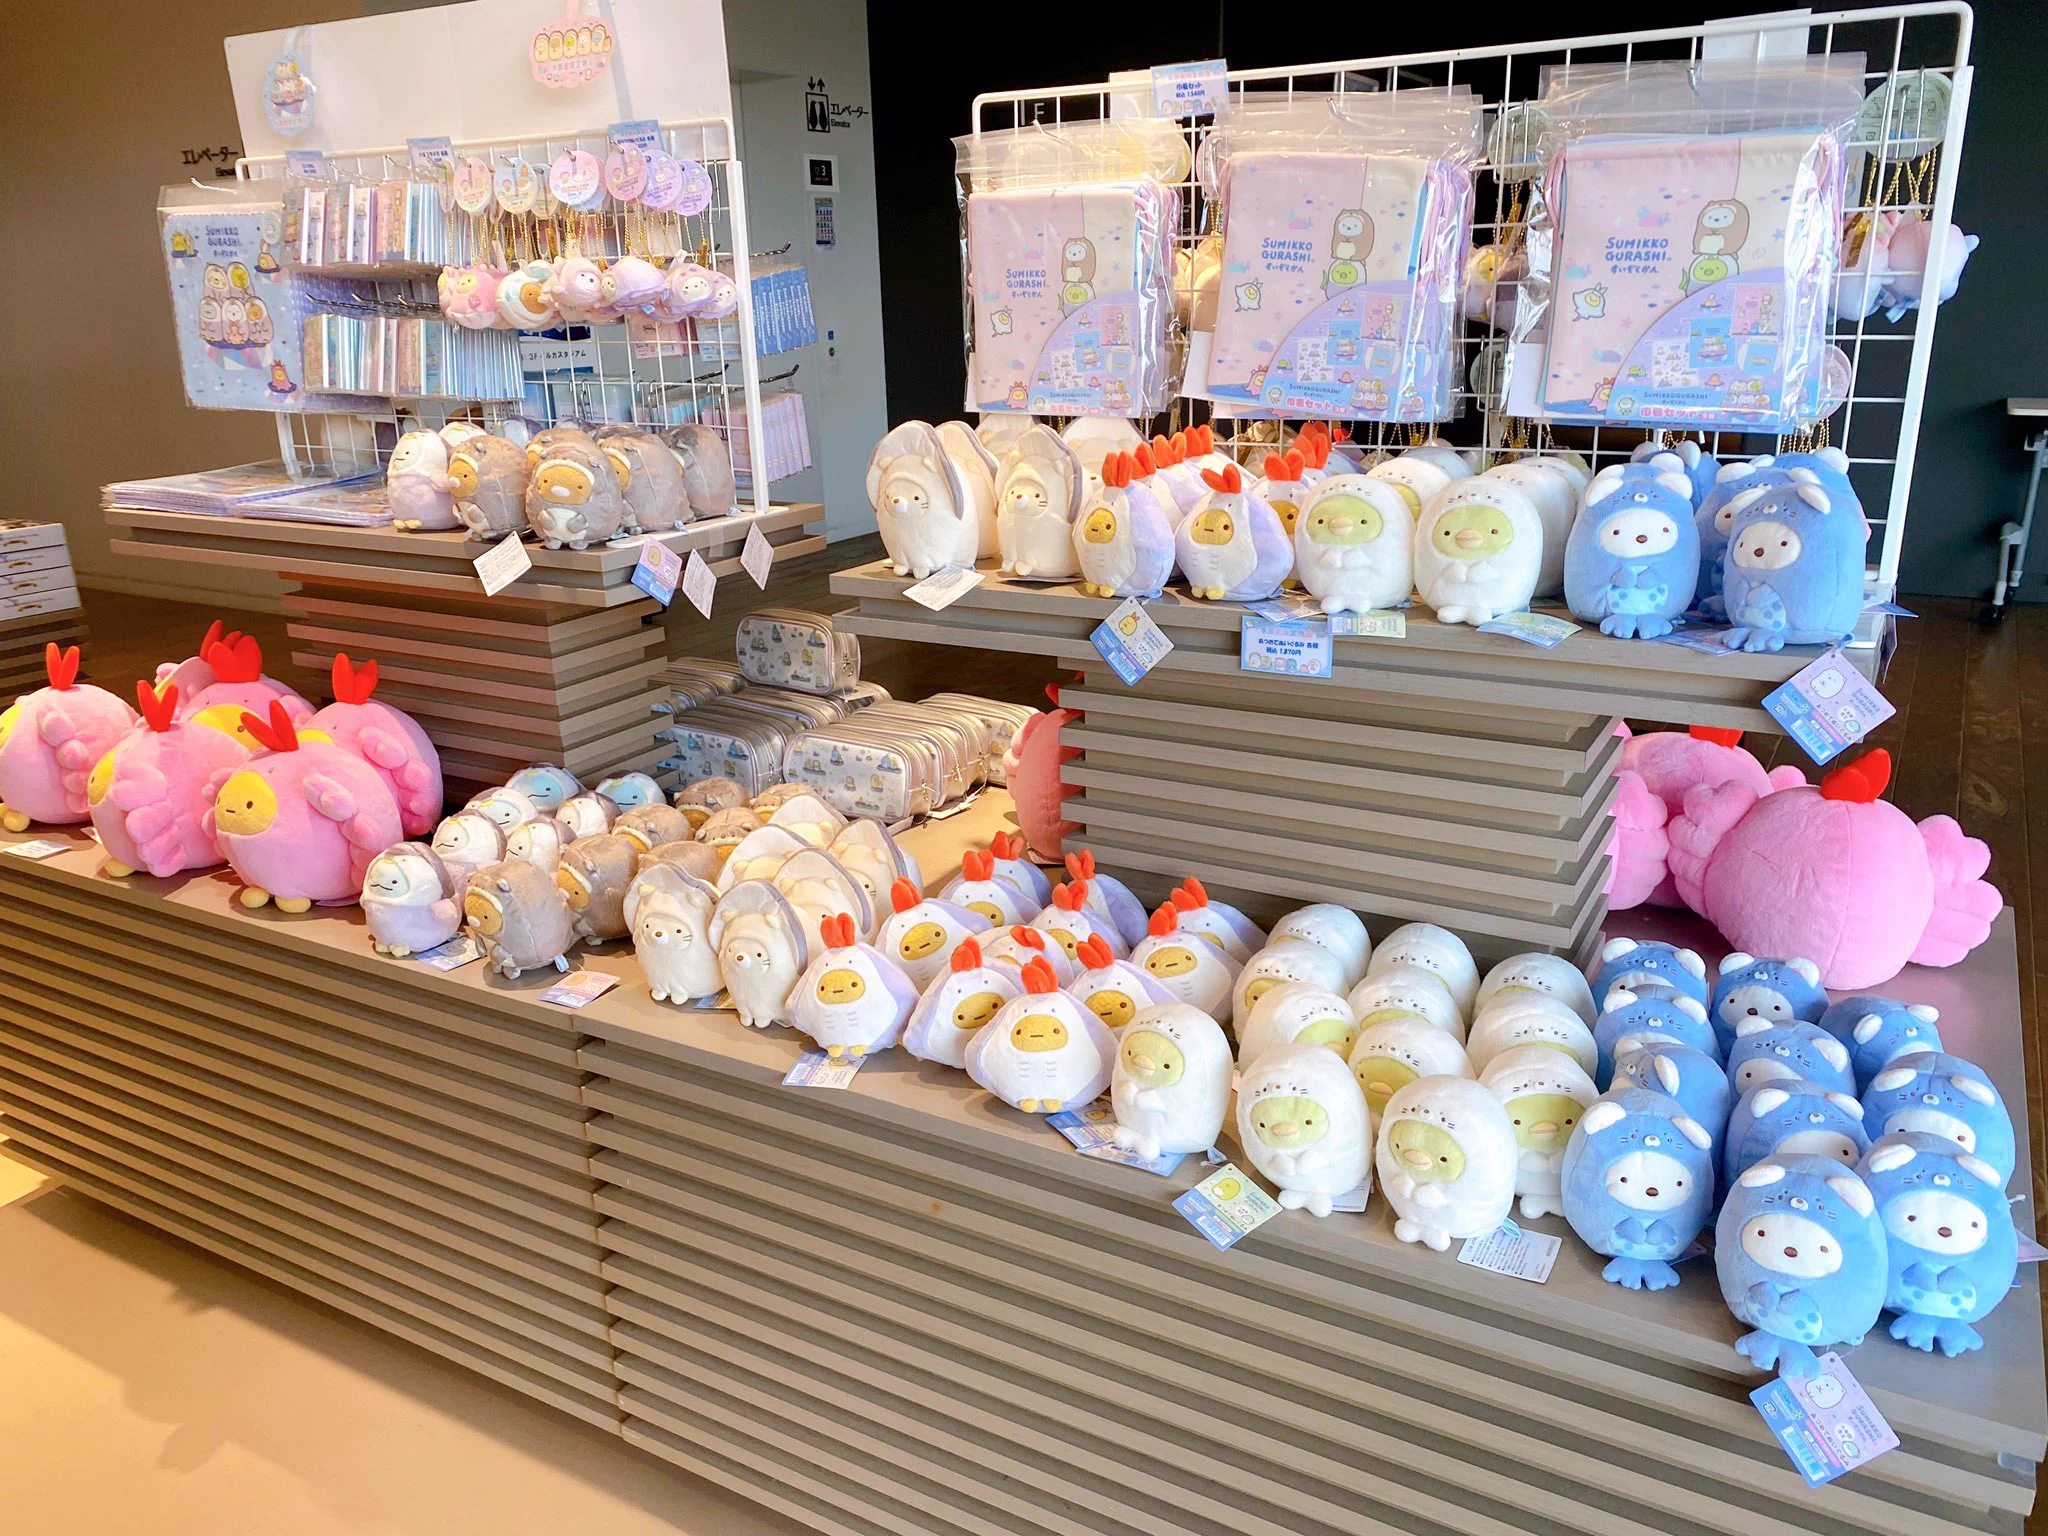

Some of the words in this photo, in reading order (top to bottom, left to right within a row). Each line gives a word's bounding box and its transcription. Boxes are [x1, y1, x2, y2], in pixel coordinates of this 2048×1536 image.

[829, 102, 869, 119] エレベーター
[181, 146, 239, 164] エレベーター
[1262, 237, 1313, 251] SUMIKKO
[1605, 237, 1669, 249] SUMIKKO
[1262, 250, 1311, 262] GURASHI
[1605, 251, 1667, 262] GURASHI
[1006, 269, 1047, 278] SUMIKKO
[1006, 280, 1047, 288] GURASHI
